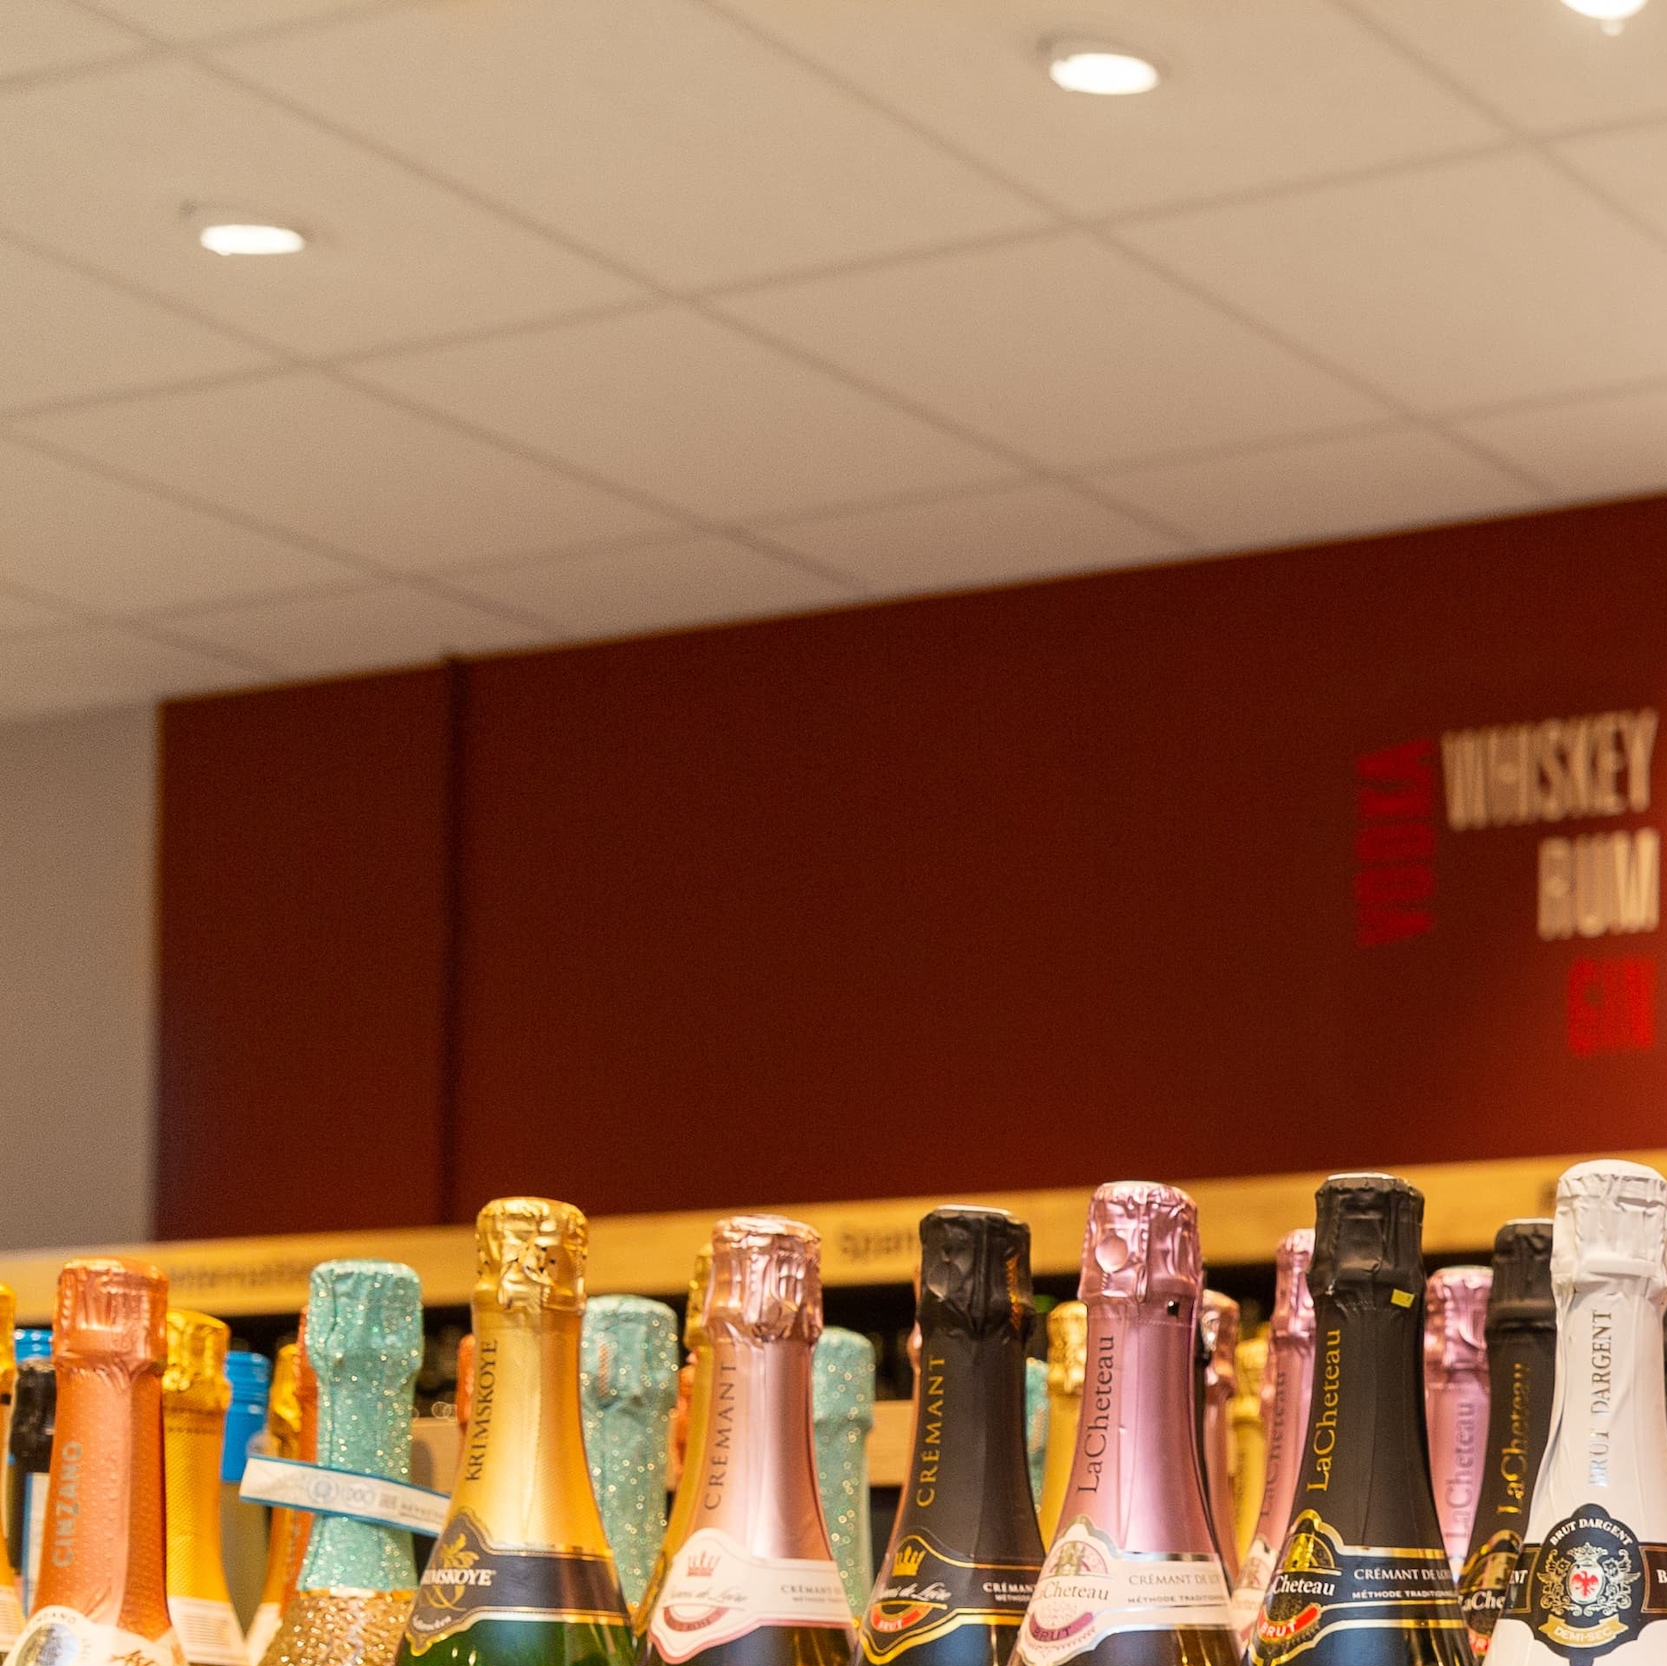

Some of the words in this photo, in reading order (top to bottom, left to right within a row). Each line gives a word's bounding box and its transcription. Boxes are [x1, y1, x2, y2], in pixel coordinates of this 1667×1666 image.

[1441, 709, 1660, 830] WHISKEY
[1537, 828, 1661, 940] RUM
[464, 1338, 499, 1482] KRIMSKOYE
[703, 1359, 738, 1511] CRÉMANT
[914, 1353, 946, 1509] CRÉMANT
[1075, 1334, 1116, 1495] LaCheteau
[1306, 1327, 1342, 1494] LaCheteau
[1261, 1620, 1299, 1641] BRUT
